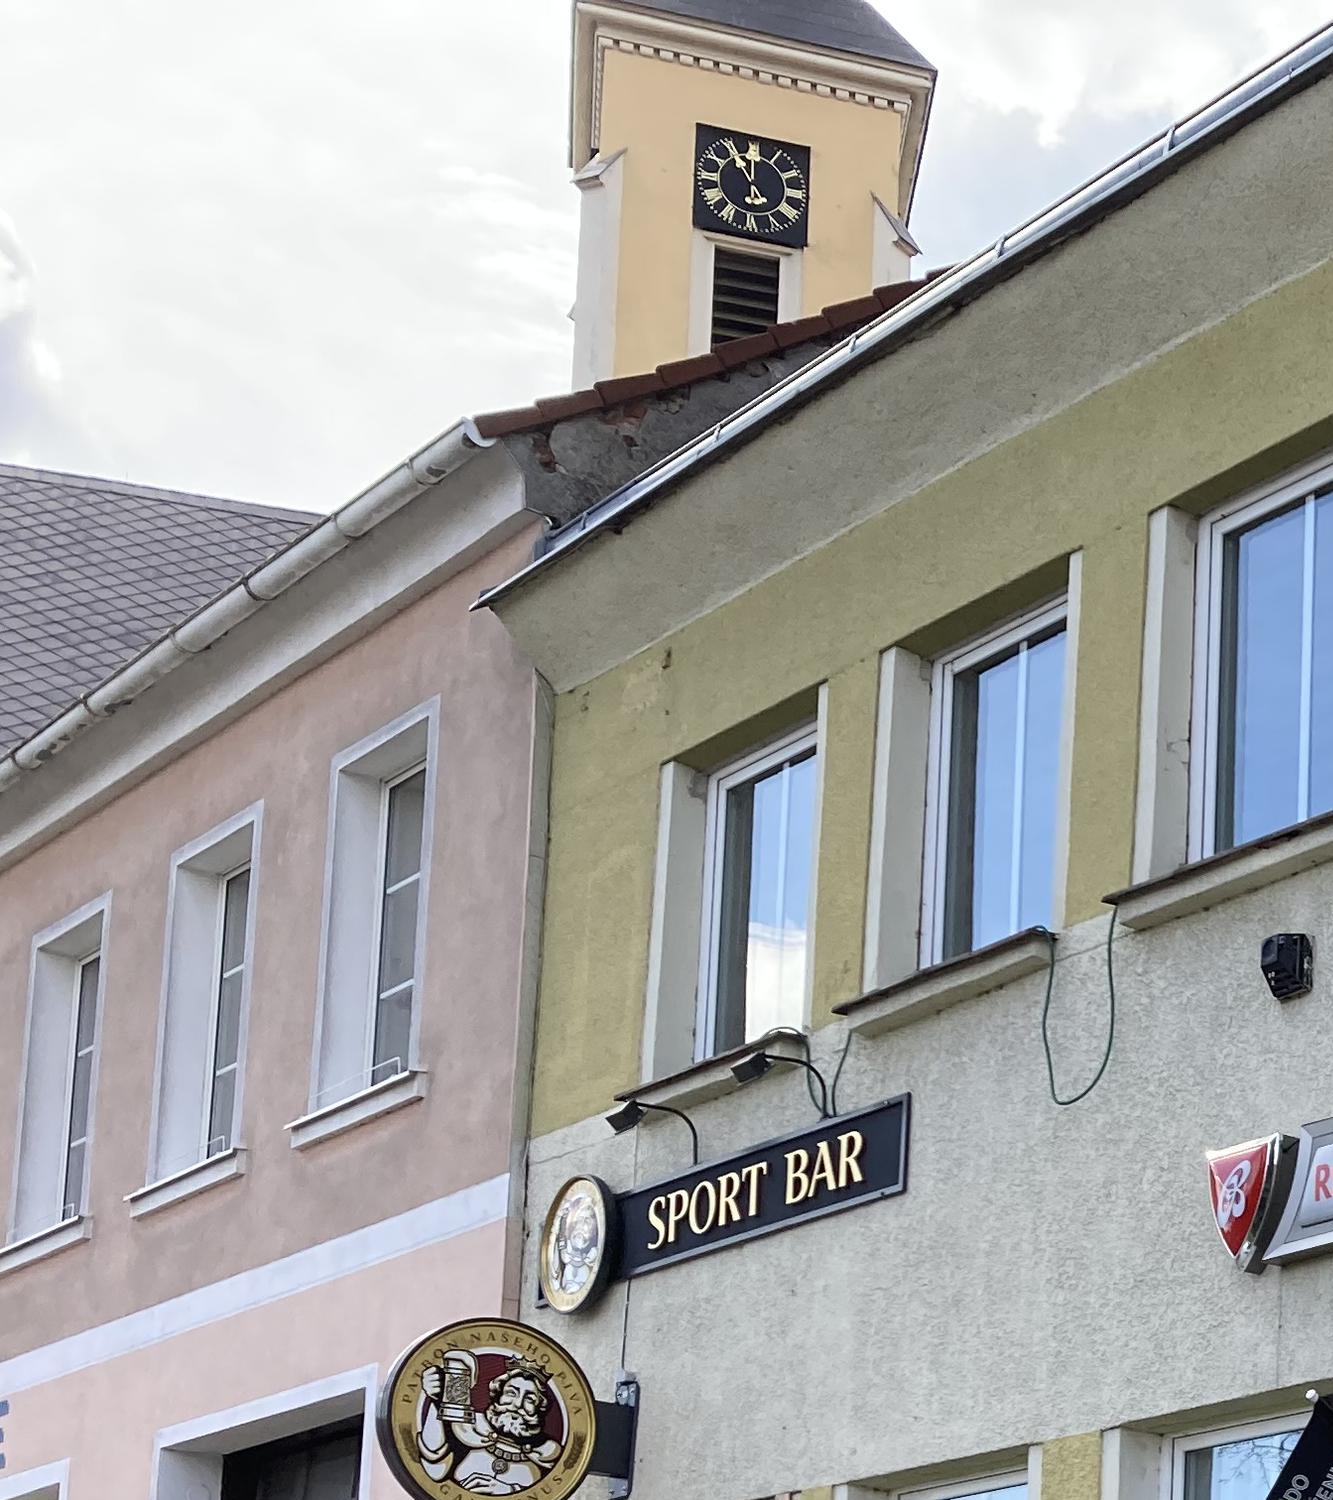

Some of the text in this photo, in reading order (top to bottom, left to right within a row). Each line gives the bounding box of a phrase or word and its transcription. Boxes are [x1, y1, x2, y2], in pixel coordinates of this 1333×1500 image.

[647, 1161, 768, 1251] SPORT
[784, 1130, 864, 1205] BAR
[554, 1371, 583, 1415] PIVA
